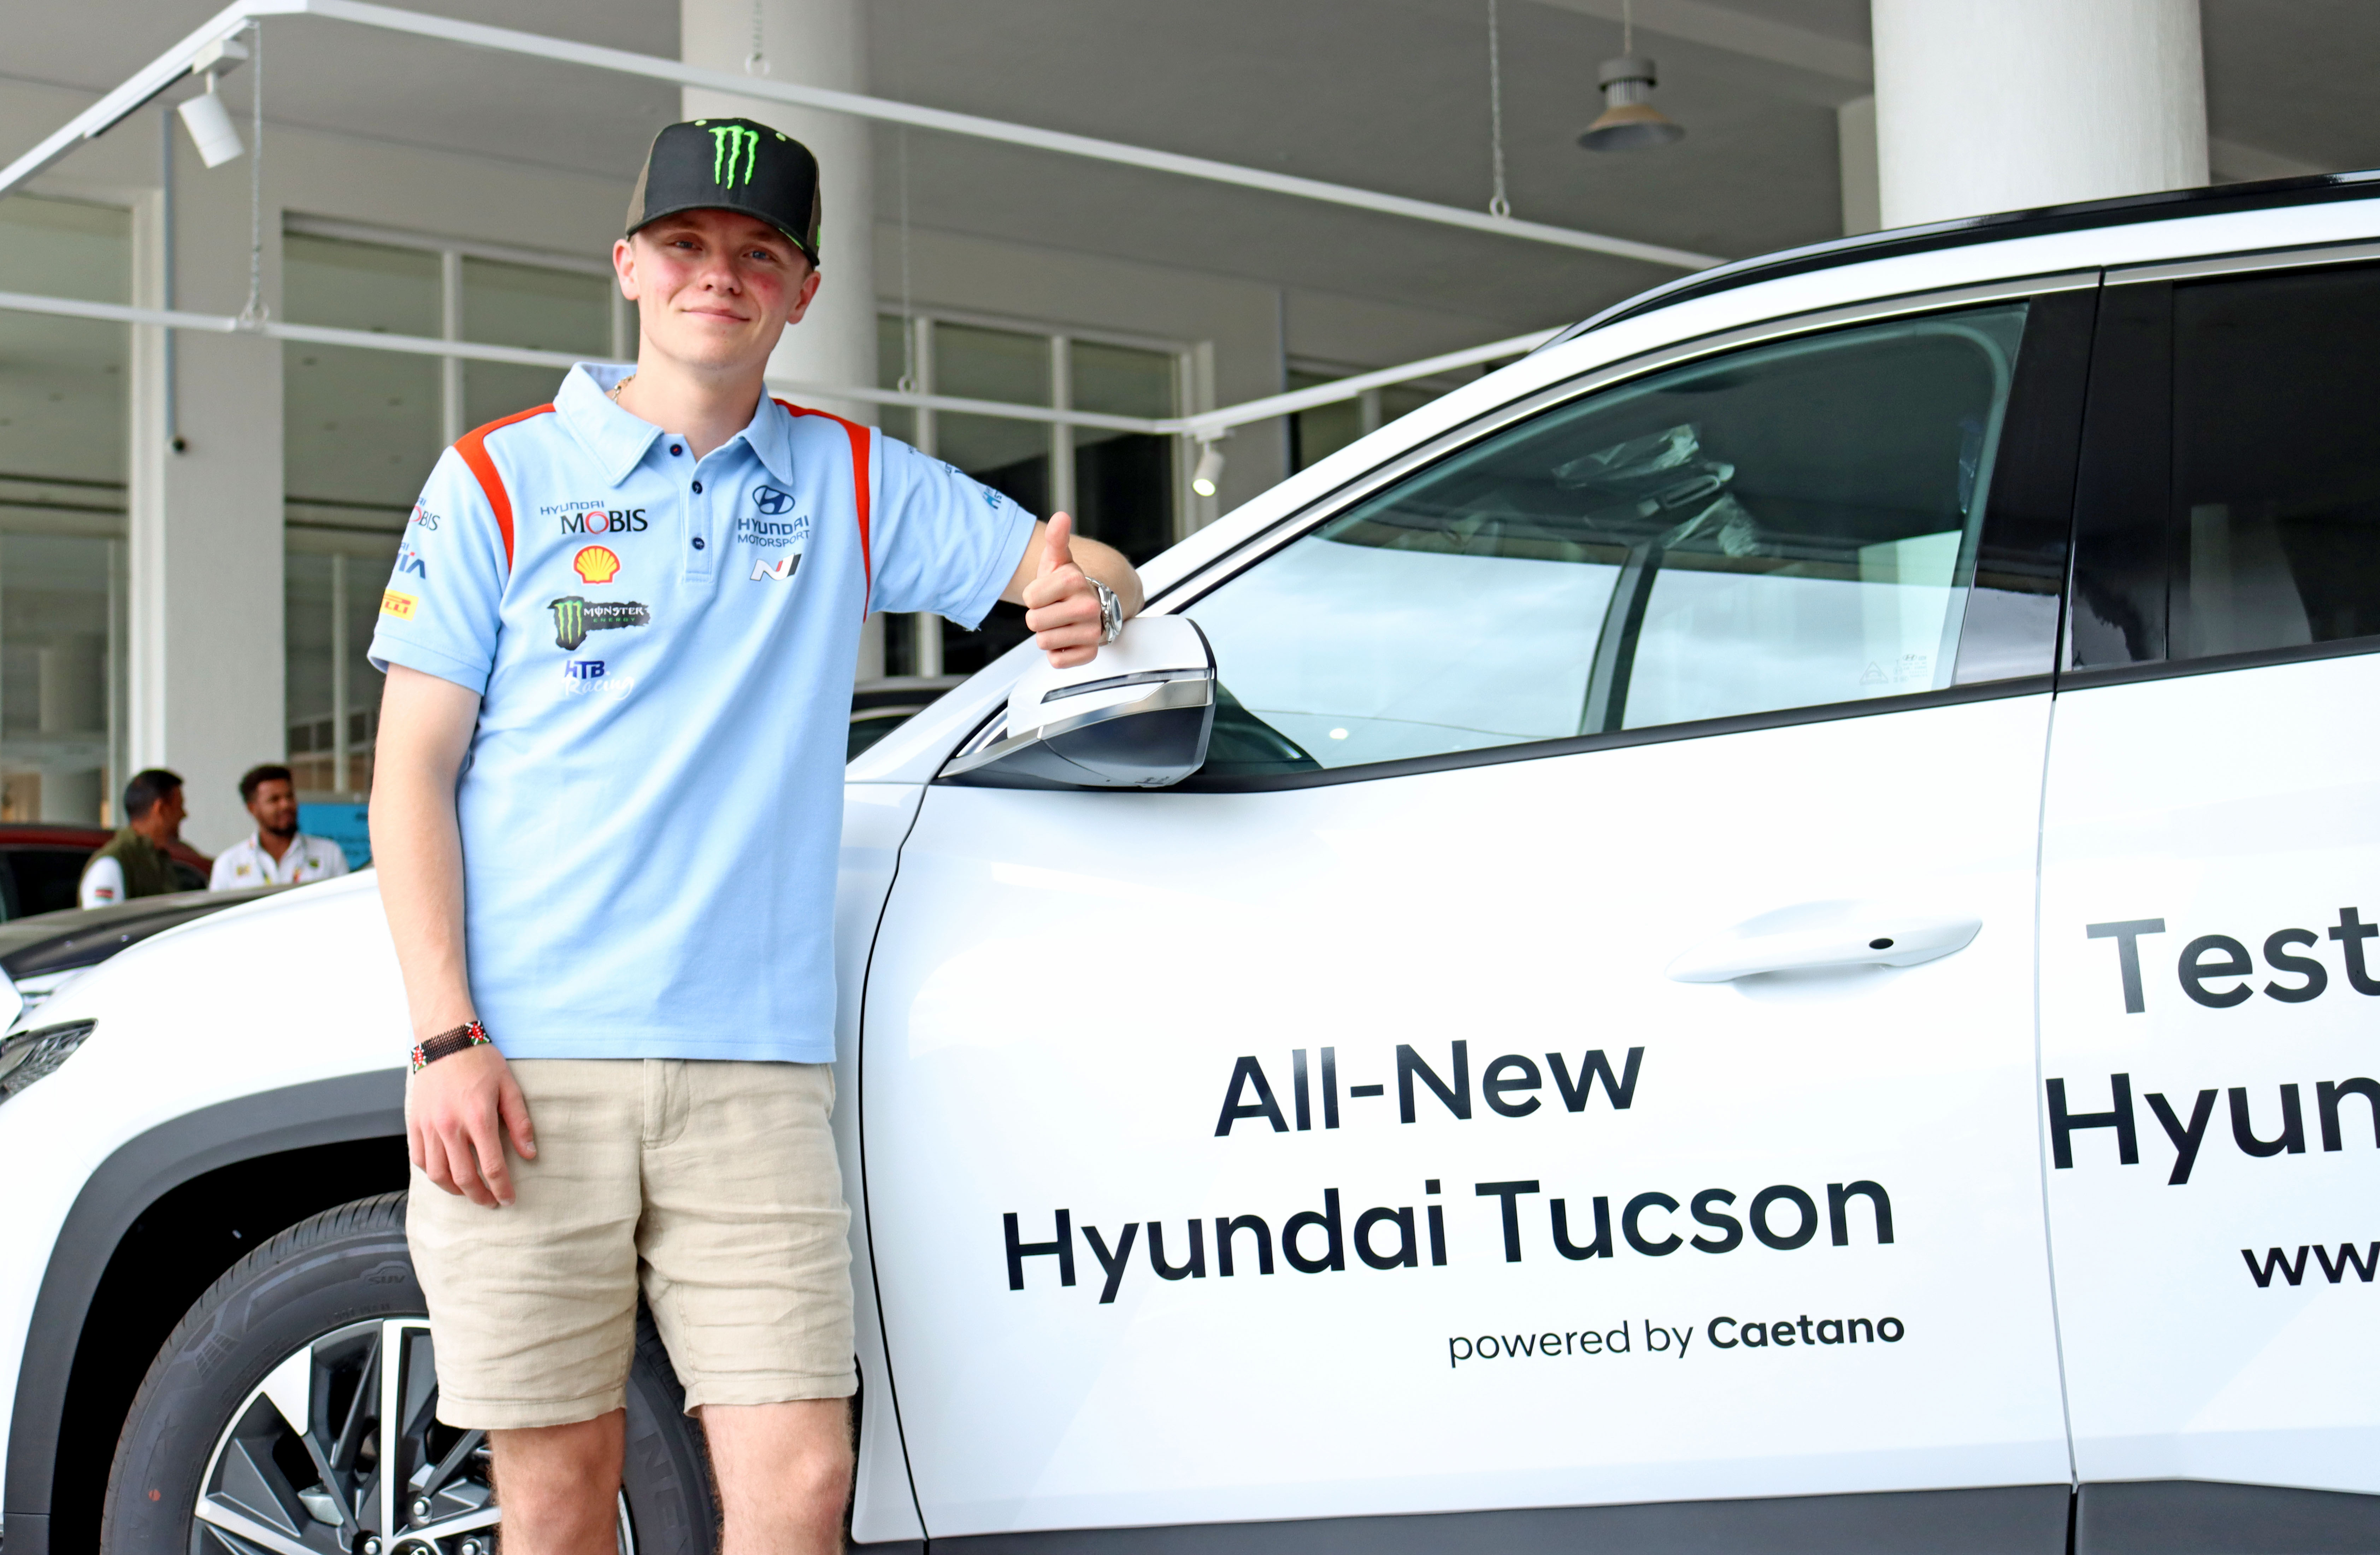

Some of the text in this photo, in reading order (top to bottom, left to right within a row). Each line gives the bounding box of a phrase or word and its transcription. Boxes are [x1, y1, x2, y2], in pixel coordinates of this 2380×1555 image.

[409, 505, 440, 531] OBIS
[540, 500, 605, 515] HYUNDAI
[560, 509, 648, 535] MOBIS
[738, 515, 809, 535] HYUNDAI
[738, 530, 809, 547] MOTORSPORT
[583, 605, 644, 618] MONSTER
[564, 660, 605, 679] HTB
[561, 671, 635, 700] Racing
[2086, 906, 2380, 1014] Test
[1214, 1040, 1645, 1137] All-New
[2046, 1073, 2380, 1185] Hyun
[1003, 1179, 1894, 1304] Hyundai Tucson
[368, 1275, 405, 1285] SUV
[1449, 1315, 1904, 1368] powered by Caetano
